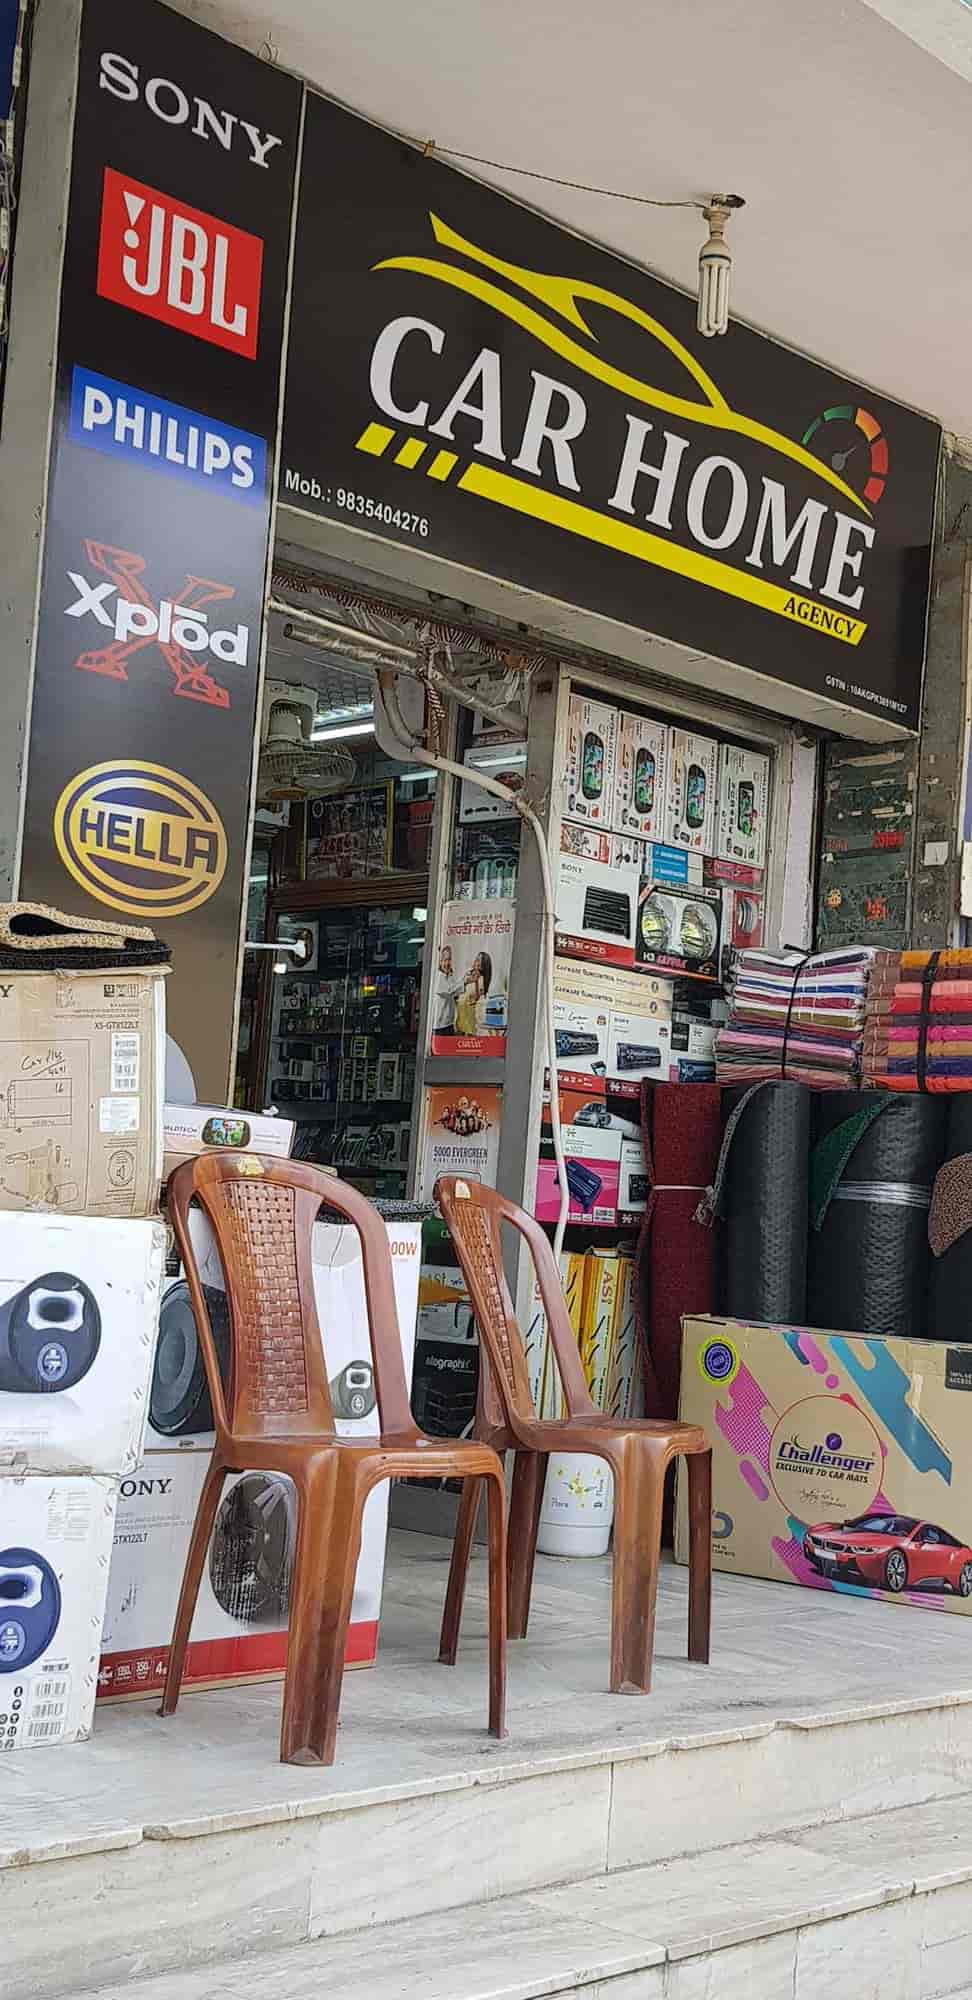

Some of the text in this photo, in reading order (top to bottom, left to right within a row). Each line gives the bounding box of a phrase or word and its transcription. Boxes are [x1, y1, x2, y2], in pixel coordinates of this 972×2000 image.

[100, 52, 282, 169] SONY
[122, 202, 248, 337] JBL
[82, 385, 255, 488] PHILIPS
[369, 315, 876, 610] CAR HOME
[285, 469, 430, 537] Mob.: 9835404276
[784, 597, 857, 637] AGENCY
[80, 808, 218, 874] HELLA
[452, 1146, 488, 1159] EVERGREEN
[388, 1241, 417, 1256] 00W
[776, 1462, 868, 1484] EXCLUSIVE 7D CAR MATS
[778, 1441, 875, 1471] Challenger
[120, 1479, 173, 1497] ONY
